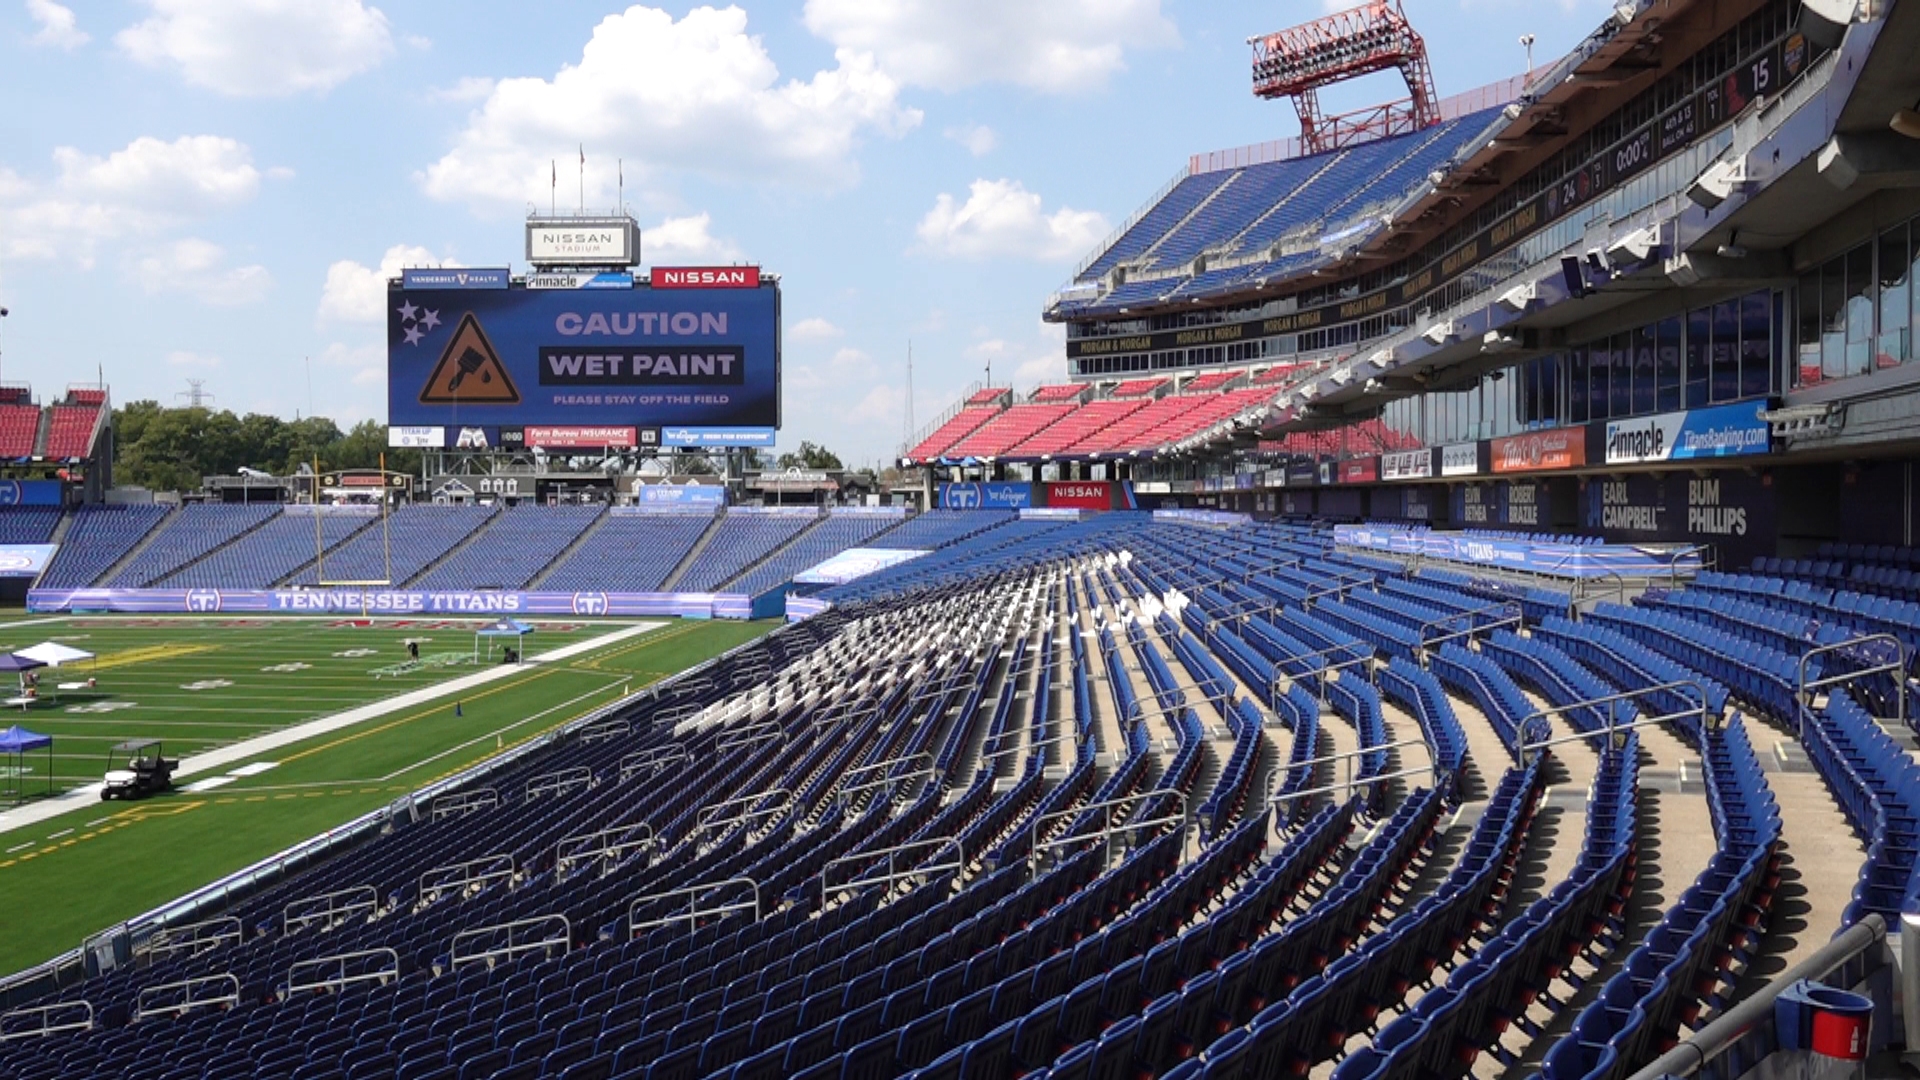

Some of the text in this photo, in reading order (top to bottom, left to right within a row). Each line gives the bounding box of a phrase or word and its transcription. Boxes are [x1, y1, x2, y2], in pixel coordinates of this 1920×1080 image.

[1752, 57, 1769, 91] 15
[1684, 105, 1692, 120] 13
[1676, 128, 1684, 140] ON
[1616, 140, 1640, 172] 0:00
[1563, 180, 1576, 205] 24
[544, 234, 612, 243] NISSAN
[555, 245, 601, 253] STADIUM
[469, 276, 499, 284] HEALTH
[528, 273, 577, 287] Pinnacle
[665, 272, 744, 283] NISSAN
[555, 312, 728, 336] CAUTION
[1263, 317, 1291, 333] MORGAN
[1176, 325, 1242, 345] MORGAN & MORGAN
[1081, 336, 1151, 353] MORGAN & MORGAN
[548, 355, 736, 376] WET PAINT
[553, 395, 730, 405] PLEASE STAY OFF THE FIELD
[531, 428, 629, 437] Farm Bureau INSURANCE
[1608, 421, 1664, 459] Pinnacle
[1684, 426, 1767, 451] TitansBanking.com
[1502, 440, 1528, 469] Tito's
[1000, 486, 1027, 507] Kroger
[1054, 487, 1103, 498] NISSAN
[1465, 486, 1481, 503] ELVIN
[1509, 484, 1536, 503] ROBERT
[1602, 482, 1628, 504] EARL
[1688, 479, 1720, 506] BUM
[1465, 504, 1487, 521] BETHEA
[1509, 505, 1538, 524] BRAZILE
[1602, 506, 1658, 531] CAMPBELL
[1688, 507, 1747, 535] PHILLIPS
[1468, 542, 1494, 560] TITANS
[275, 592, 423, 609] TENNESSEE
[429, 591, 519, 609] TITANS
